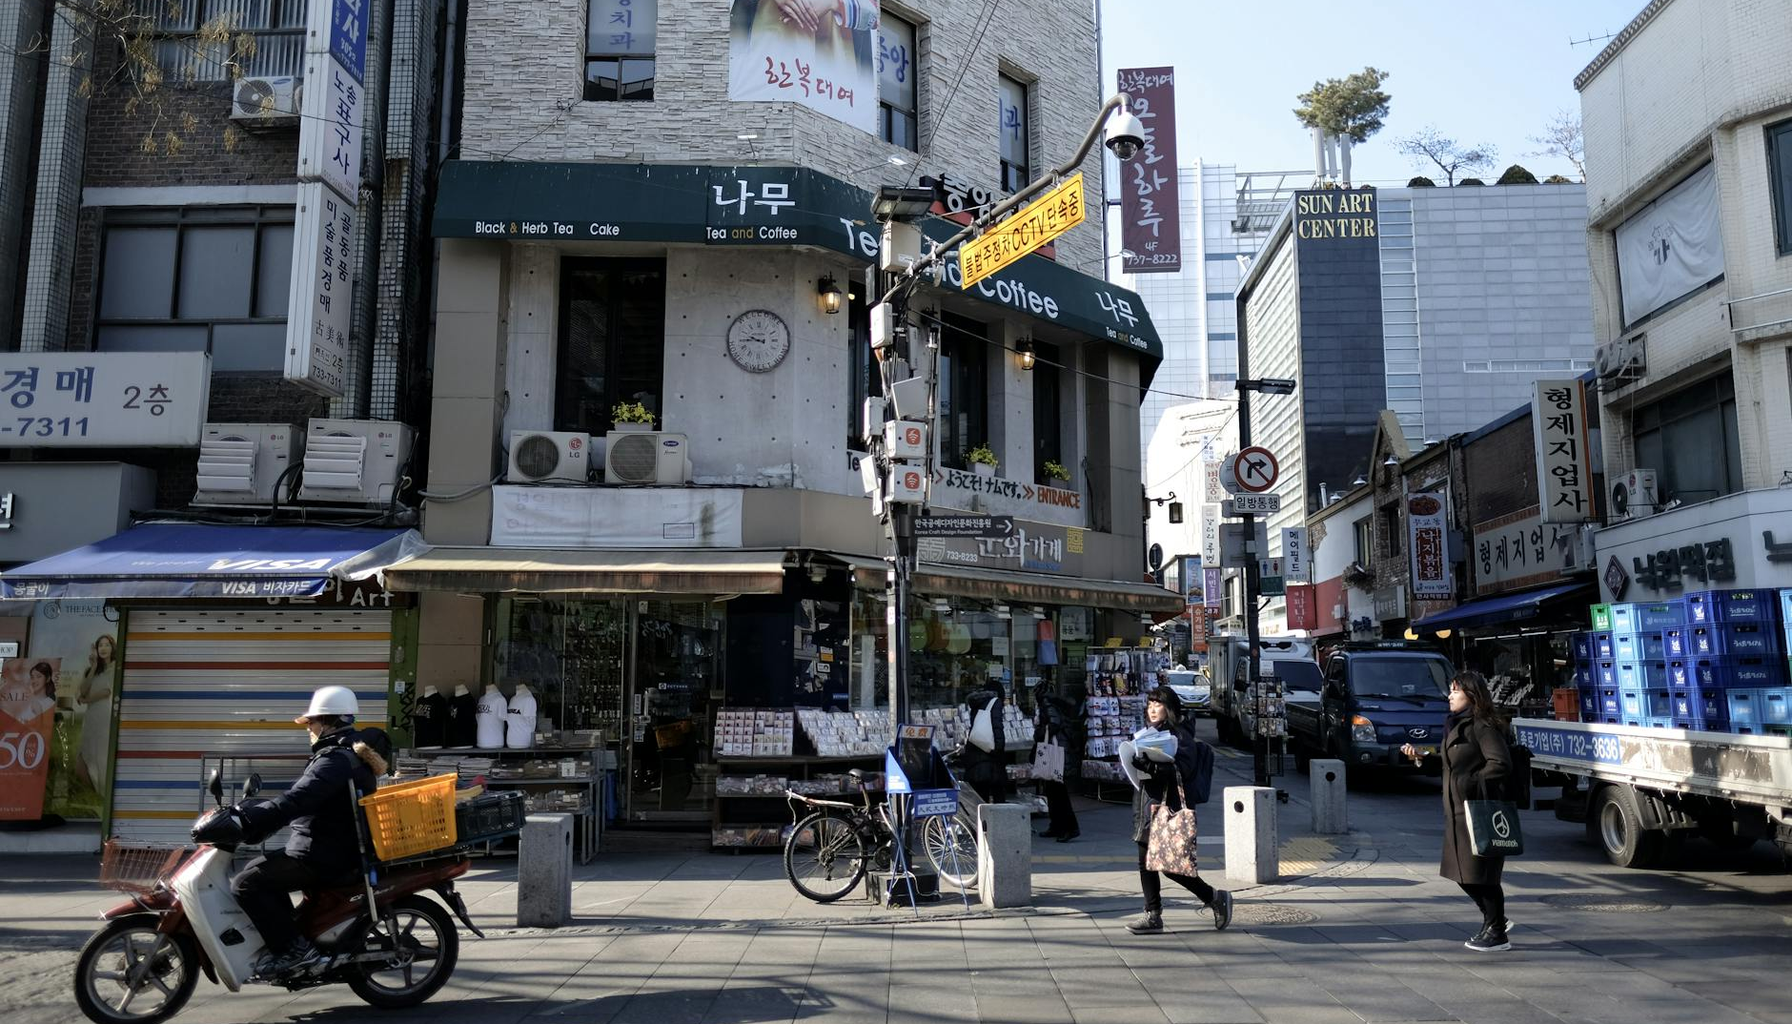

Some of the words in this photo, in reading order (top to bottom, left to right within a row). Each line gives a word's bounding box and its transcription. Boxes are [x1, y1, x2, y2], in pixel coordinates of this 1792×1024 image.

[712, 179, 796, 216] 나무
[1298, 194, 1334, 215] SUN
[1338, 193, 1373, 213] ART
[475, 221, 506, 234] Black
[509, 222, 518, 234] &
[521, 222, 549, 234] Herb
[553, 222, 574, 235] Tea
[590, 223, 620, 236] Cake
[706, 227, 727, 239] Tea
[731, 227, 754, 239] and
[758, 227, 798, 240] Coffee
[1298, 217, 1377, 239] CENTER
[1127, 253, 1178, 266] 737-8222
[1095, 291, 1140, 328] 나무
[1106, 326, 1118, 339] Tea
[1118, 330, 1129, 343] and
[1129, 333, 1149, 350] Coffee
[312, 365, 342, 389] 733-7311
[122, 383, 173, 417] 2층
[568, 451, 580, 459] LG
[1543, 387, 1588, 514] 형제지업사
[1037, 486, 1081, 510] ENTRANCE
[1236, 495, 1279, 511] 일방통행
[207, 558, 332, 571] VISA
[946, 550, 978, 563] 733-8233
[221, 582, 257, 595] VISA
[261, 579, 312, 595] 비자카드
[350, 586, 395, 607] Art
[1567, 734, 1619, 761] 732-3636
